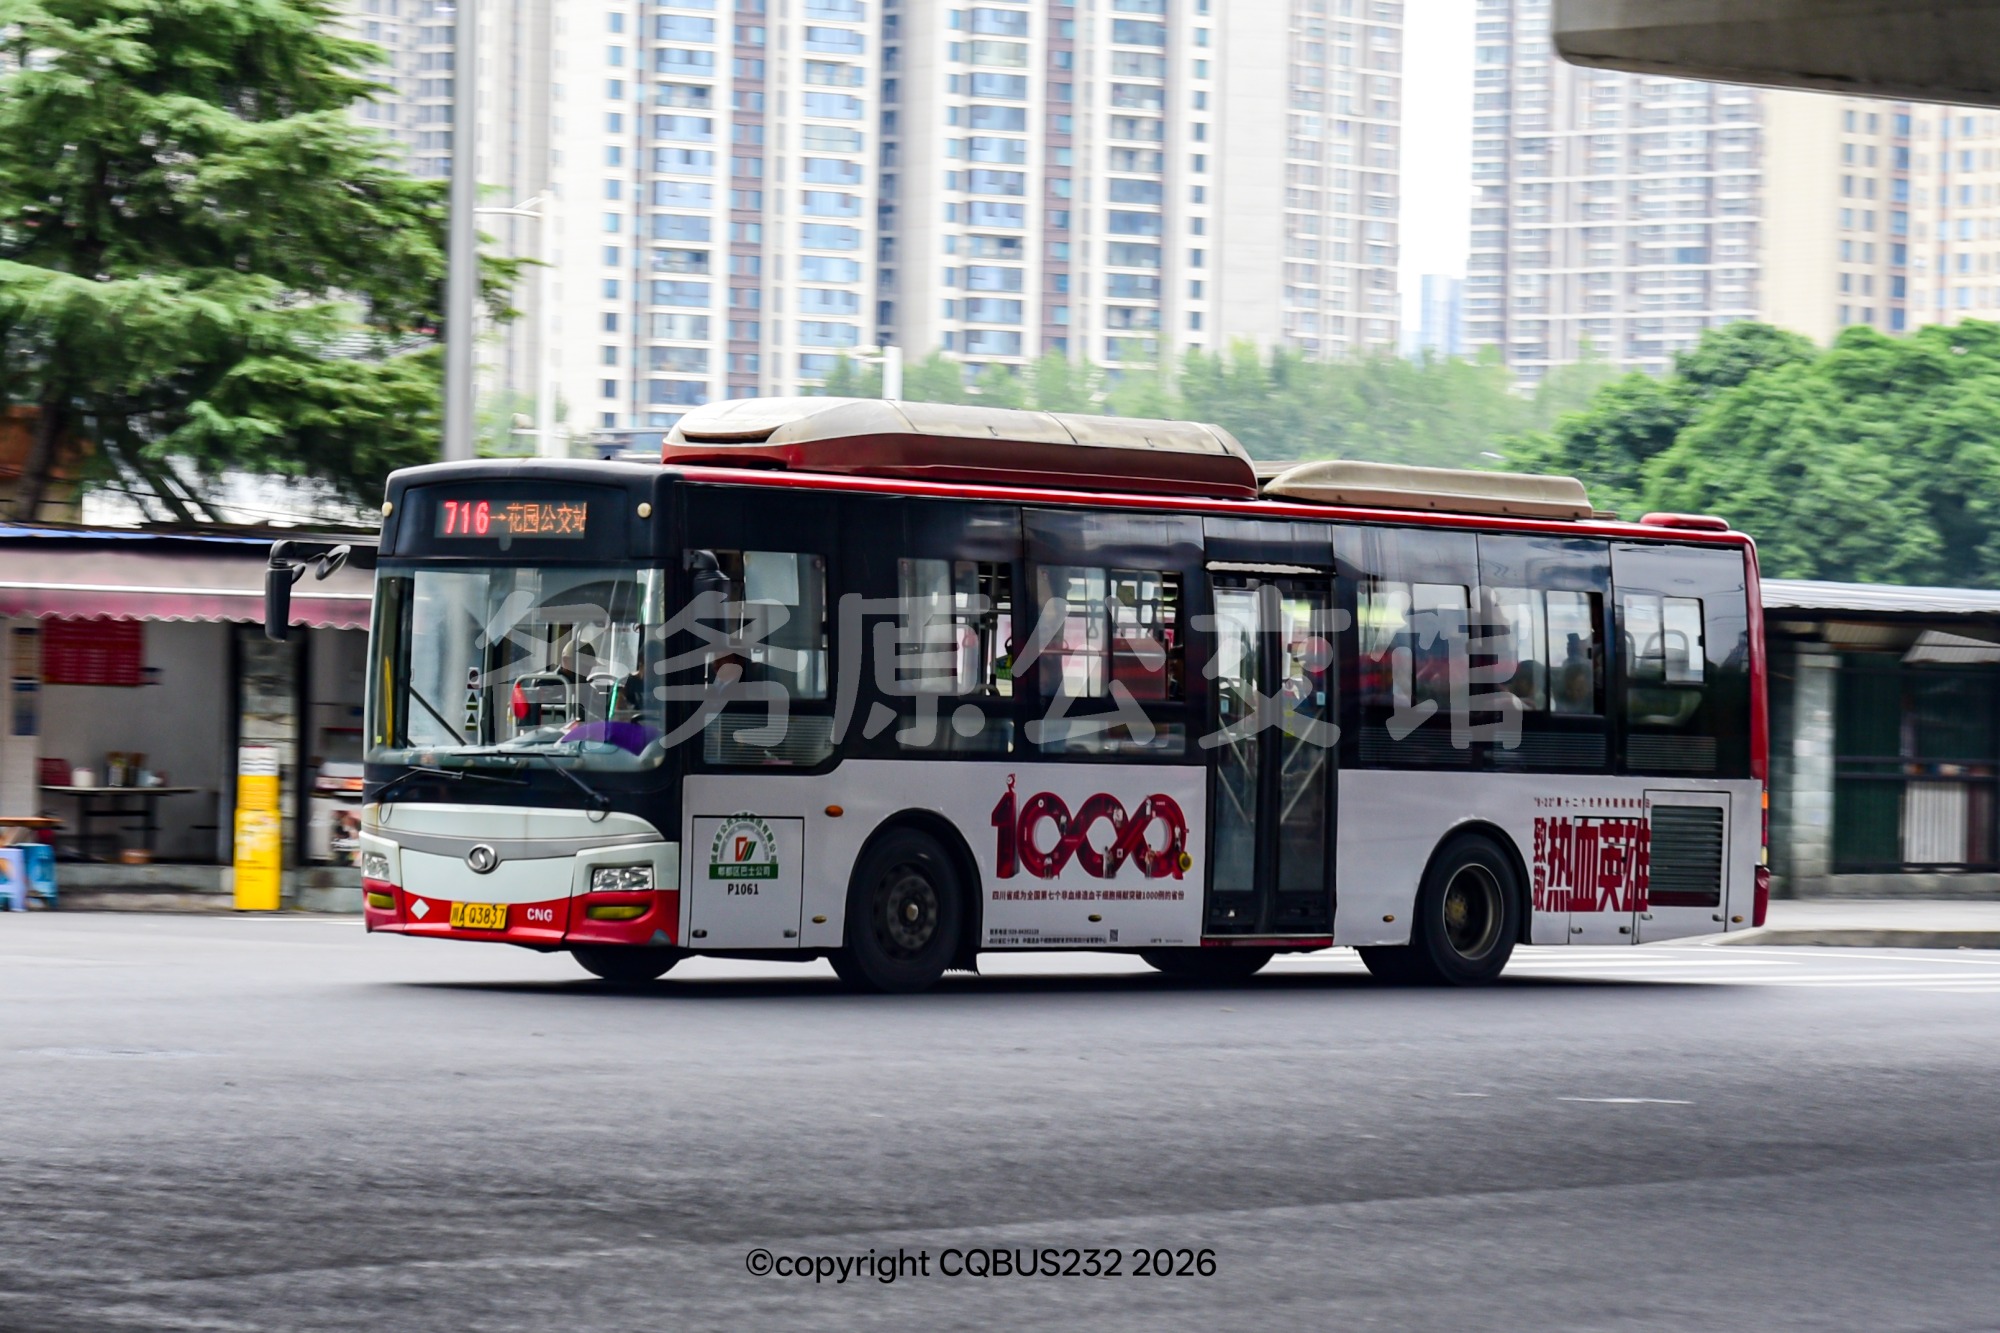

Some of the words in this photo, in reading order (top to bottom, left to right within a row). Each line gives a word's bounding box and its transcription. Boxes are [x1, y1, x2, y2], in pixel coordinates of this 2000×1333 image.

[443, 501, 490, 534] 716
[991, 791, 1188, 880] 1000
[727, 883, 759, 896] P1061
[527, 908, 553, 922] CNG
